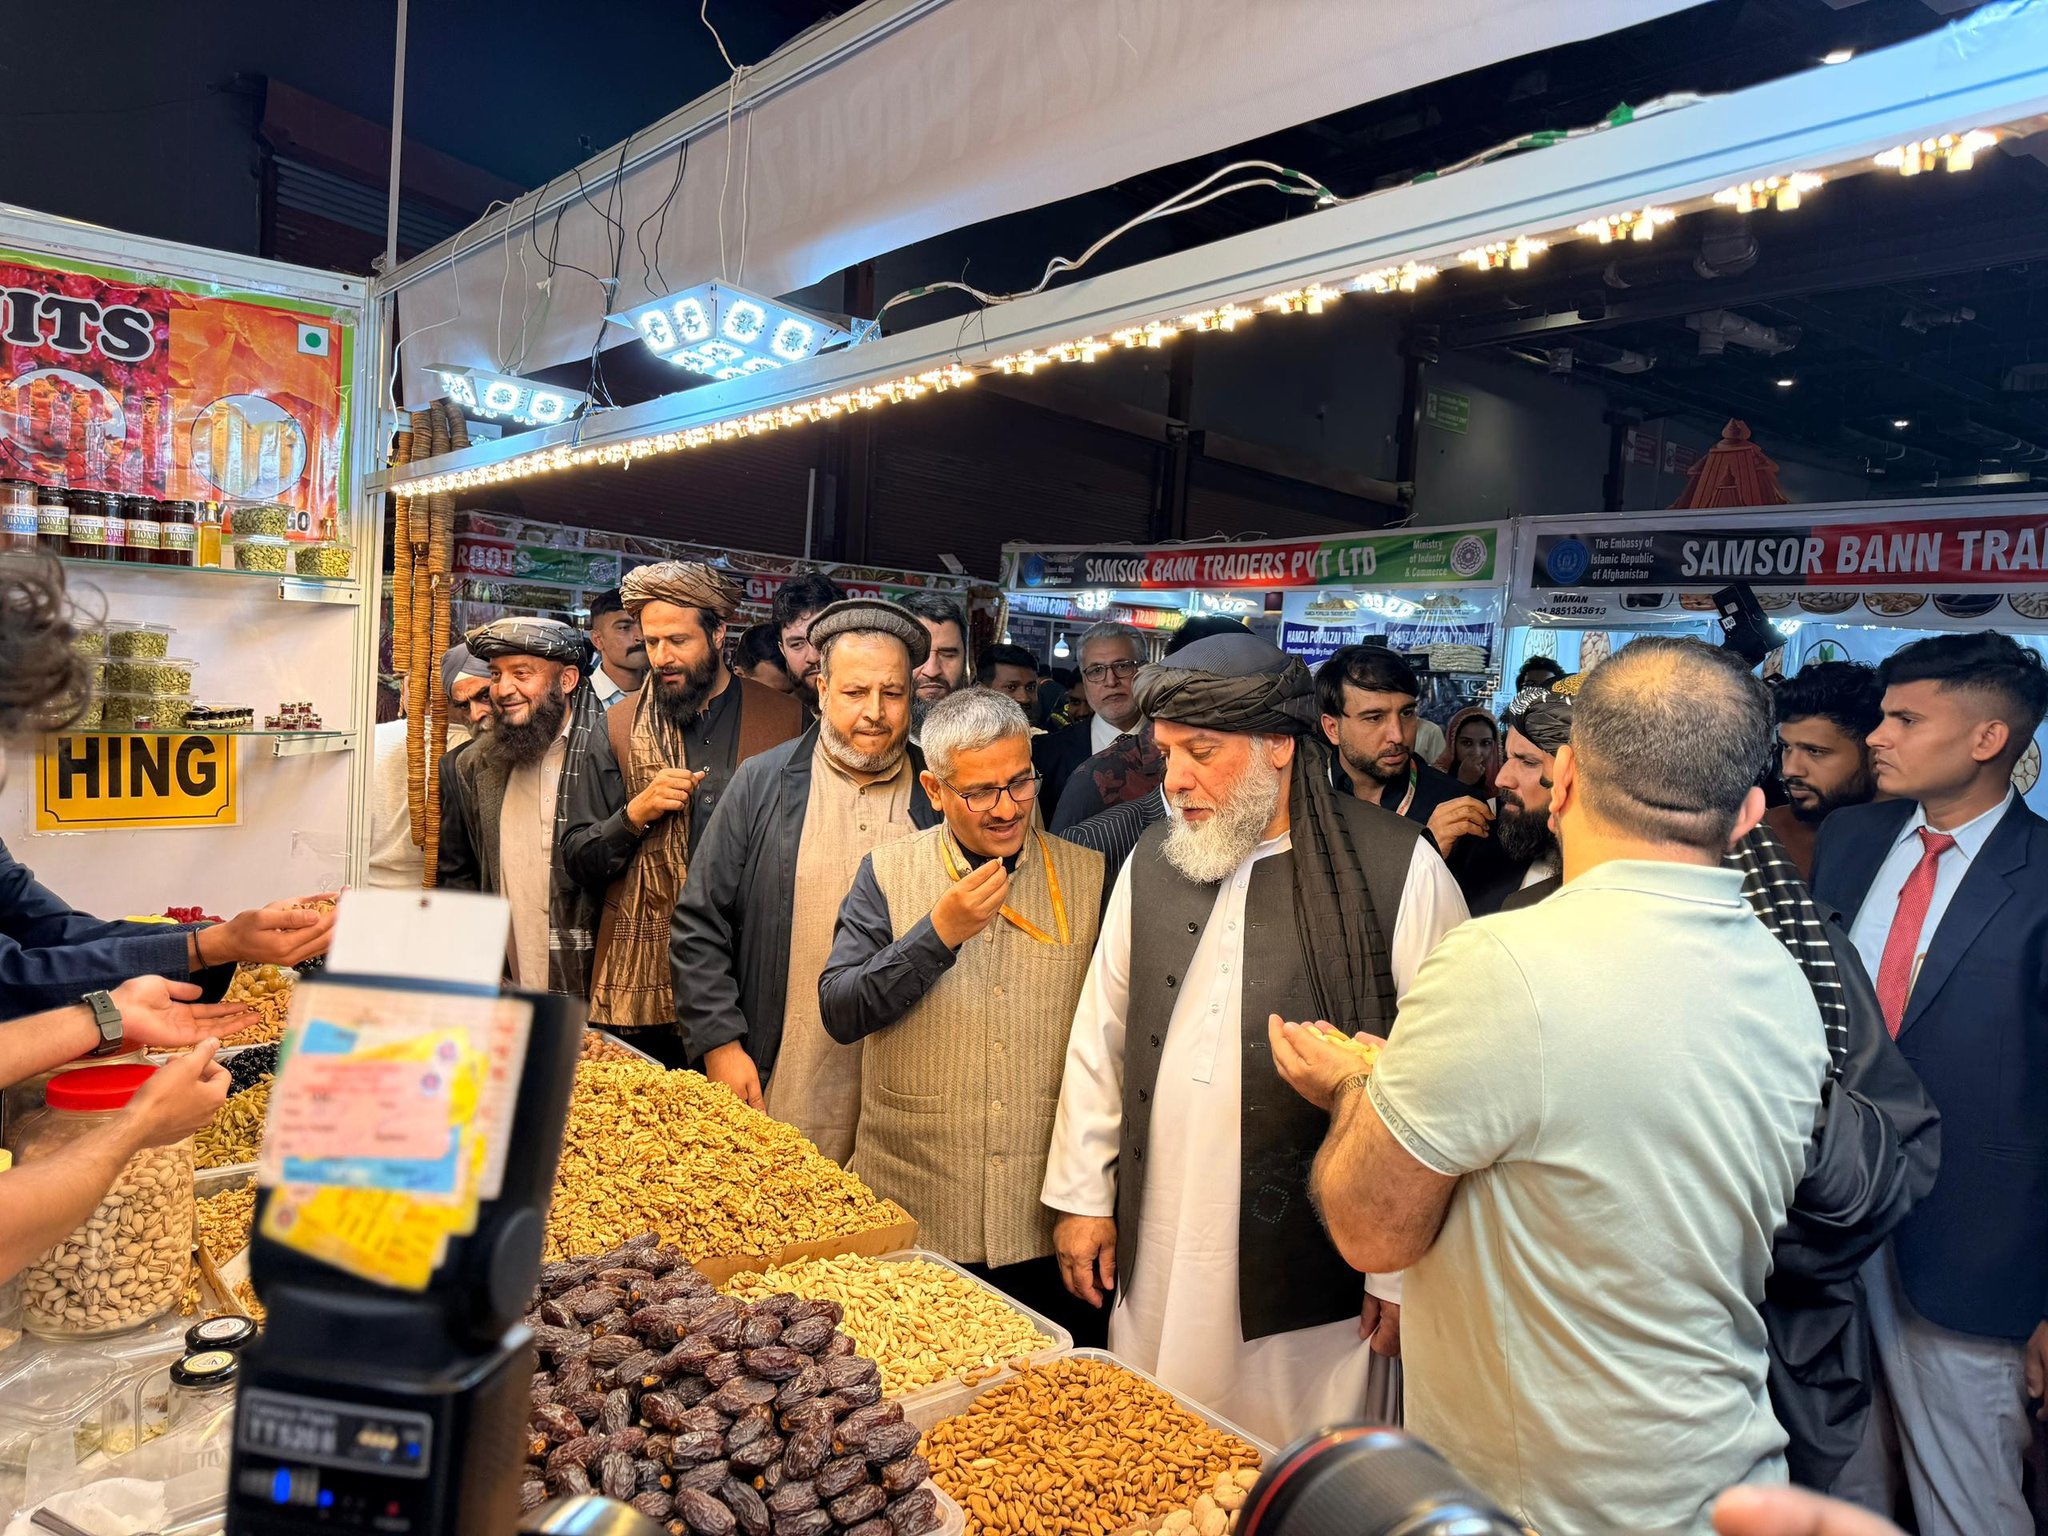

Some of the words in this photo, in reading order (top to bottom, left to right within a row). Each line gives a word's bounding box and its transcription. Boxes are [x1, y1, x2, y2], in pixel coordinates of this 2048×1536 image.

[0, 287, 153, 359] ITS
[1413, 540, 1443, 550] Ministry
[1595, 539, 1609, 549] The
[1610, 538, 1644, 550] Embassy
[1644, 537, 1654, 548] of
[456, 545, 536, 573] ROOTS
[1409, 555, 1417, 563] of
[1418, 554, 1447, 564] Industry
[1591, 554, 1619, 565] Islamic
[1620, 553, 1654, 566] Republic
[1681, 537, 1825, 577] SAMSOR
[1836, 532, 1943, 574] BANN
[1957, 528, 2048, 571] TRA
[1085, 558, 1150, 583] SAMSOR
[1151, 556, 1199, 582] BANN
[1203, 552, 1286, 580] TRADERS
[1291, 549, 1333, 578] PVT
[1338, 546, 1377, 577] LTD
[1412, 567, 1448, 577] Commerce
[1592, 569, 1601, 580] of
[1602, 568, 1649, 582] Afghanistan
[1027, 596, 1048, 613] HIGH
[1553, 595, 1589, 604] MANAN
[1286, 630, 1309, 643] HAMZA
[1309, 631, 1341, 645] POPALZAI
[58, 736, 217, 799] HING
